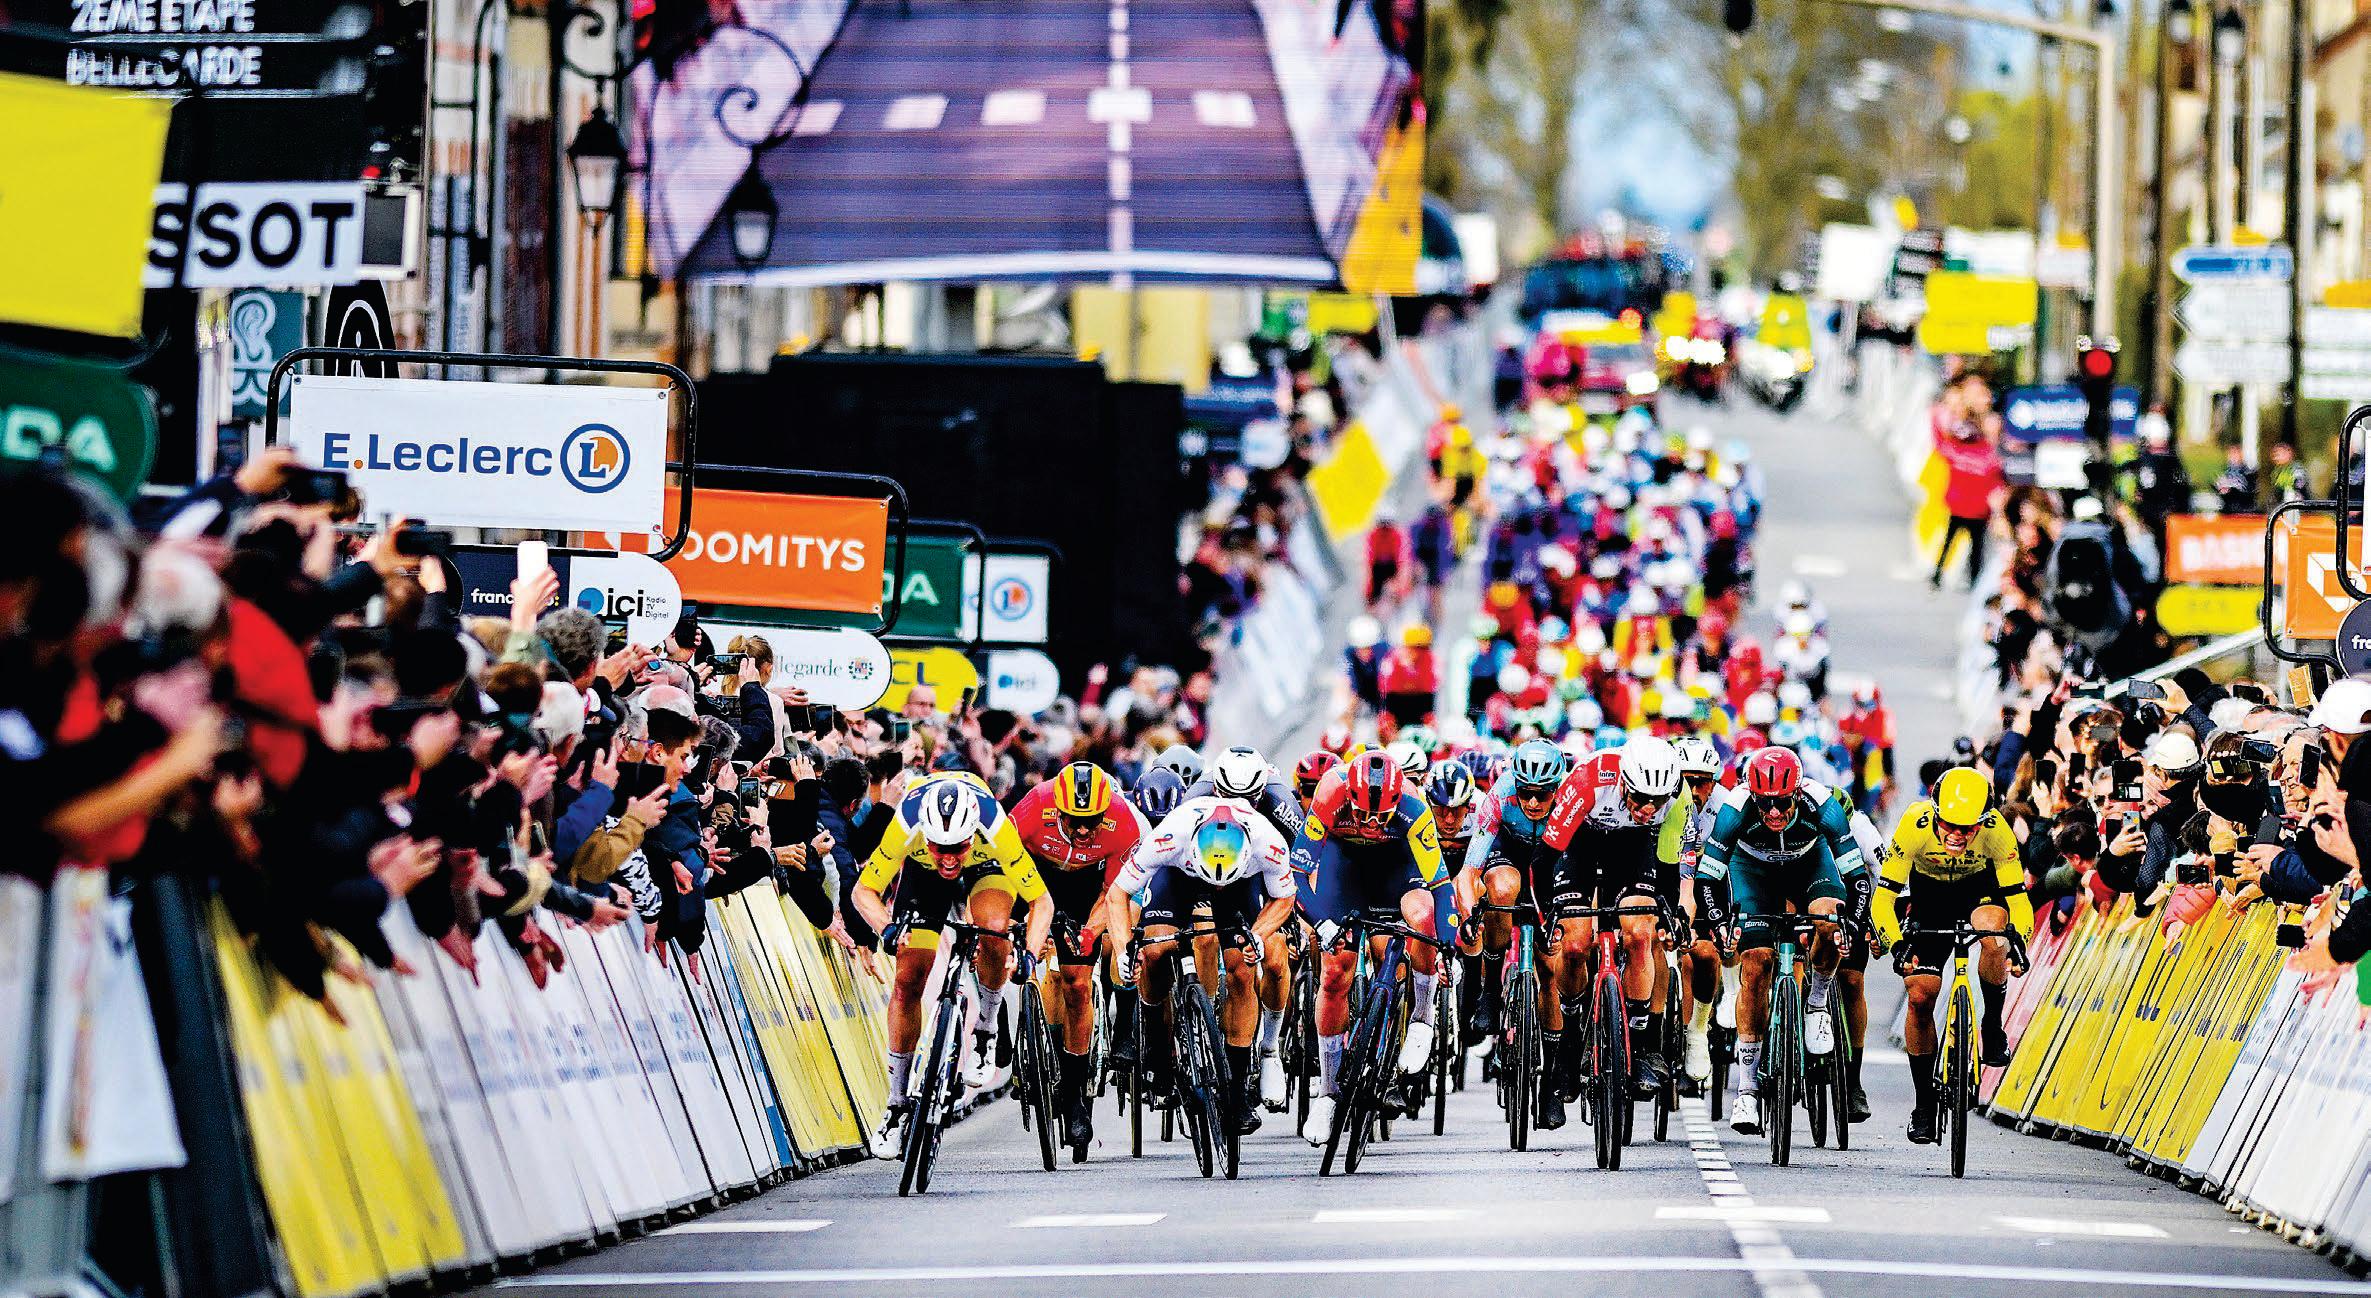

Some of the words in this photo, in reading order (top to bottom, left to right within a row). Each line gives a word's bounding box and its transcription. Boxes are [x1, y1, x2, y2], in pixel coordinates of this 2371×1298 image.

[322, 432, 553, 478] E.Leclerc
[682, 530, 866, 572] DOMITYS
[606, 587, 645, 618] ici
